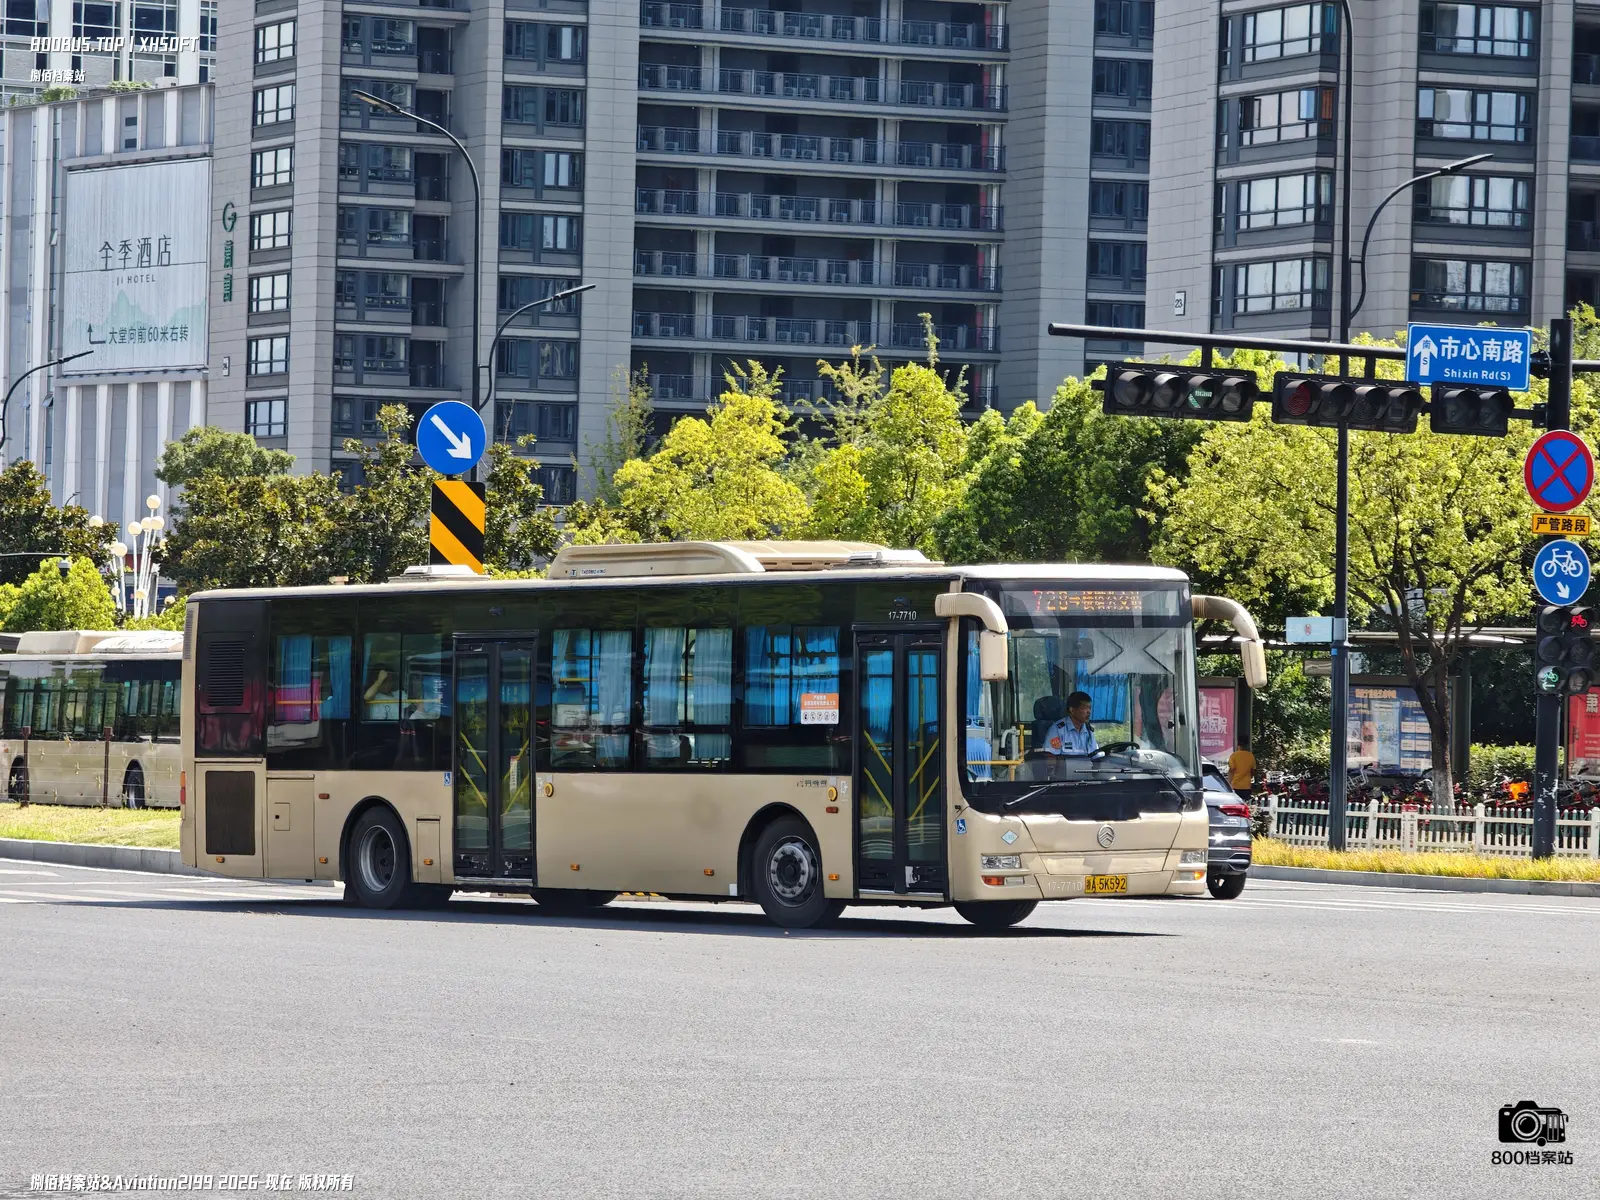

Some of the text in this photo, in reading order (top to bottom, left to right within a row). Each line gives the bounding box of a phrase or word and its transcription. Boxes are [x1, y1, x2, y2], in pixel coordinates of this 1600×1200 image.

[99, 234, 172, 271] 全季酒店
[127, 274, 156, 284] HOTEL
[1174, 298, 1183, 309] 23
[108, 324, 189, 345] 大堂向前60米右转
[1439, 335, 1524, 364] 市心南路
[1422, 356, 1429, 366] S
[1443, 368, 1512, 382] Shixin Rd(S)
[1535, 516, 1587, 533] 严管路段
[888, 610, 917, 621] 17-7710
[1047, 881, 1083, 891] 17-7710
